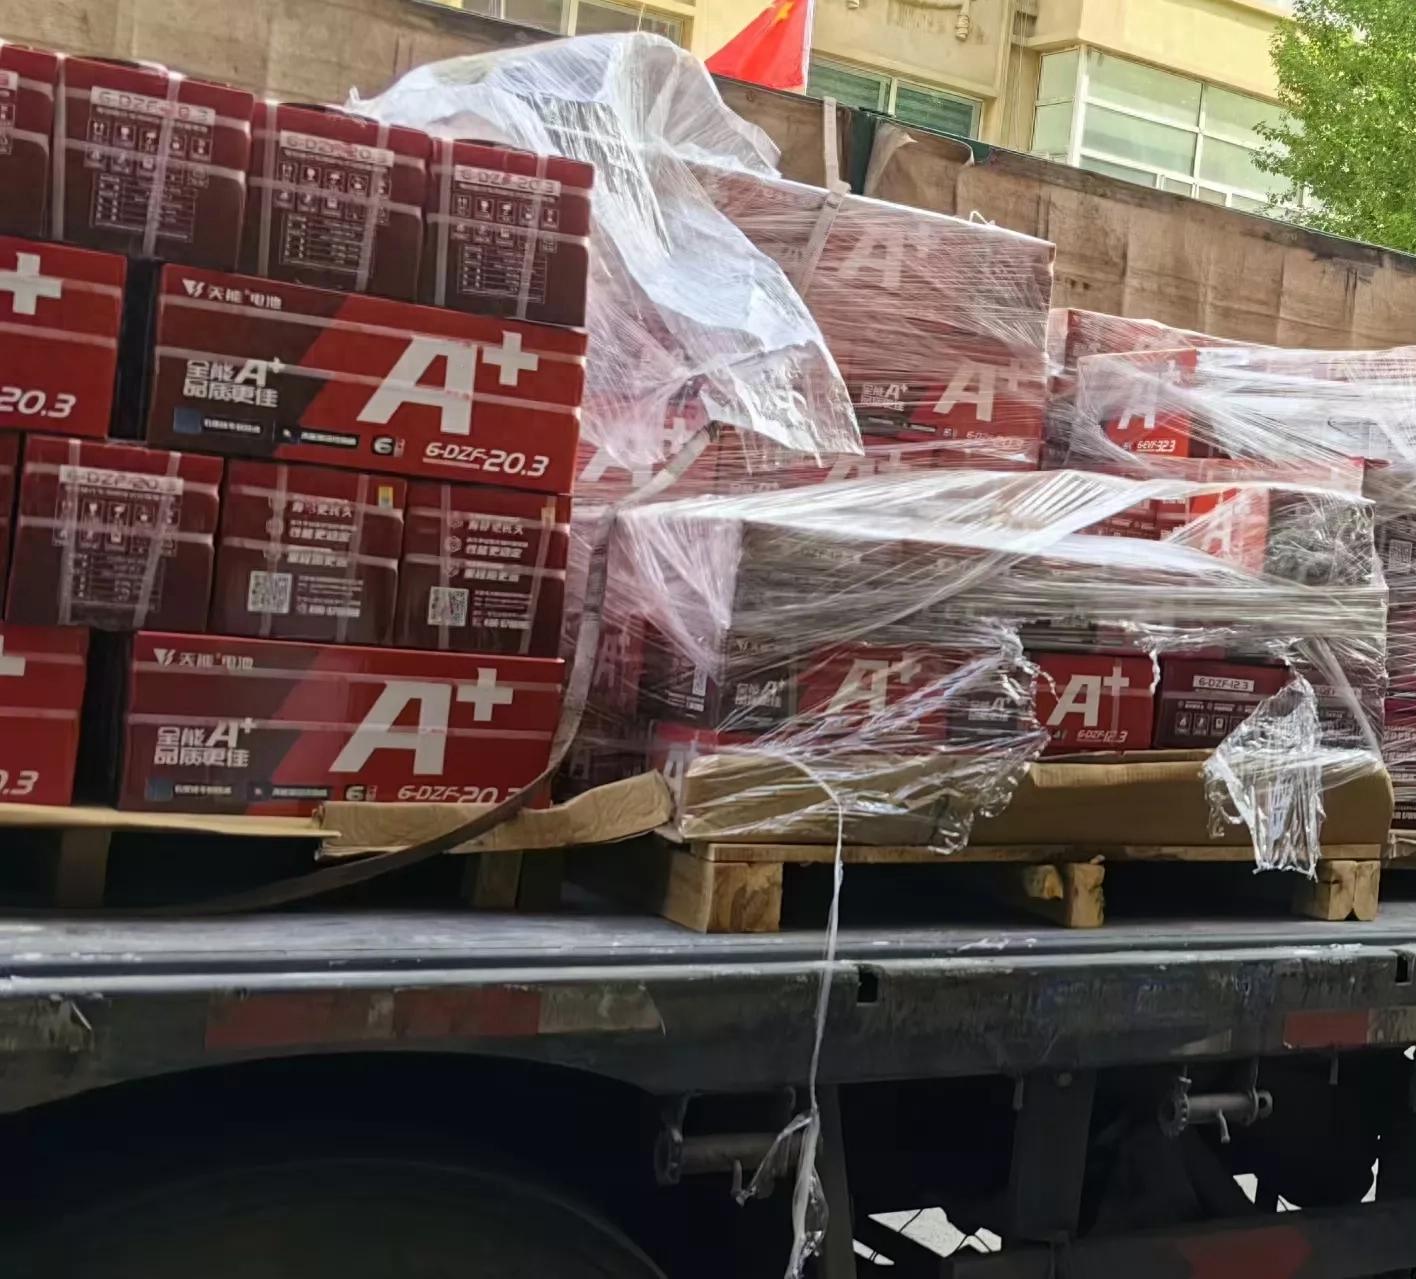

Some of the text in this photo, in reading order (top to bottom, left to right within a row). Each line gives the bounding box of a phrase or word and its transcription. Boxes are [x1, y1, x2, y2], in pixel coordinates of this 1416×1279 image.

[183, 377, 279, 408] 品质更佳
[356, 330, 539, 435] A+
[933, 358, 1027, 422] A+
[425, 442, 550, 477] 6-DZF-20.3
[826, 652, 921, 713] A+
[1047, 666, 1129, 726] A+
[1199, 679, 1249, 690] 6-DZF-12.3
[328, 667, 514, 775] A+
[154, 746, 249, 767] 品质更佳
[398, 785, 525, 803] 6-DZF-20
